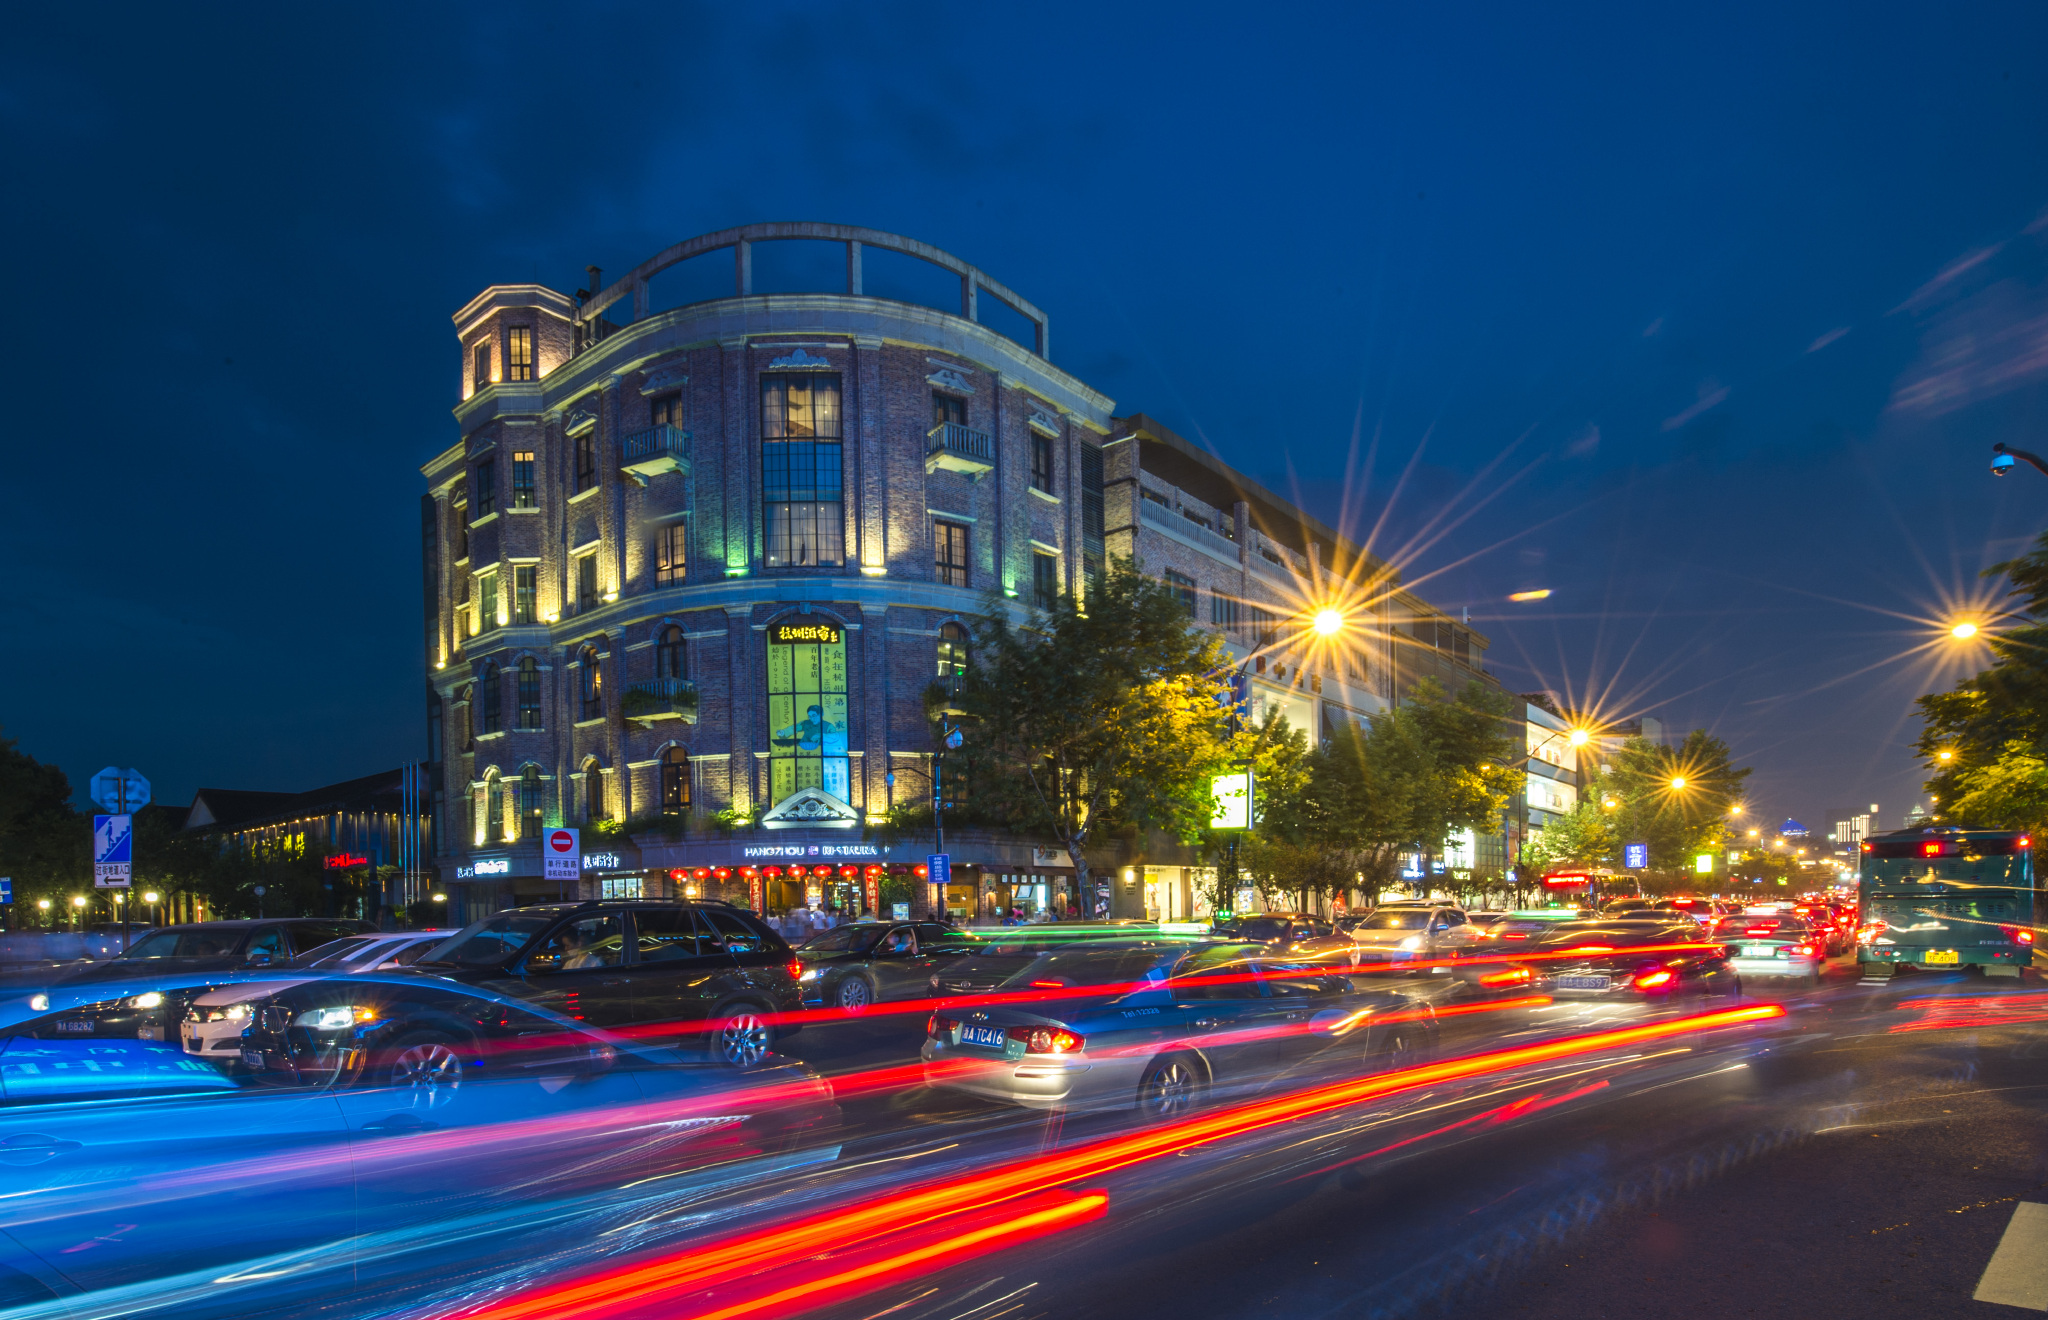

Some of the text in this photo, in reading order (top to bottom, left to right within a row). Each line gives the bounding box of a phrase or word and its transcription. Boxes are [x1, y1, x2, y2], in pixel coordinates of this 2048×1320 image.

[779, 625, 829, 641] 杭州酒家
[745, 846, 805, 857] HANGZHOU
[548, 860, 577, 868] 单行道路
[96, 865, 130, 876] 过街地道入口
